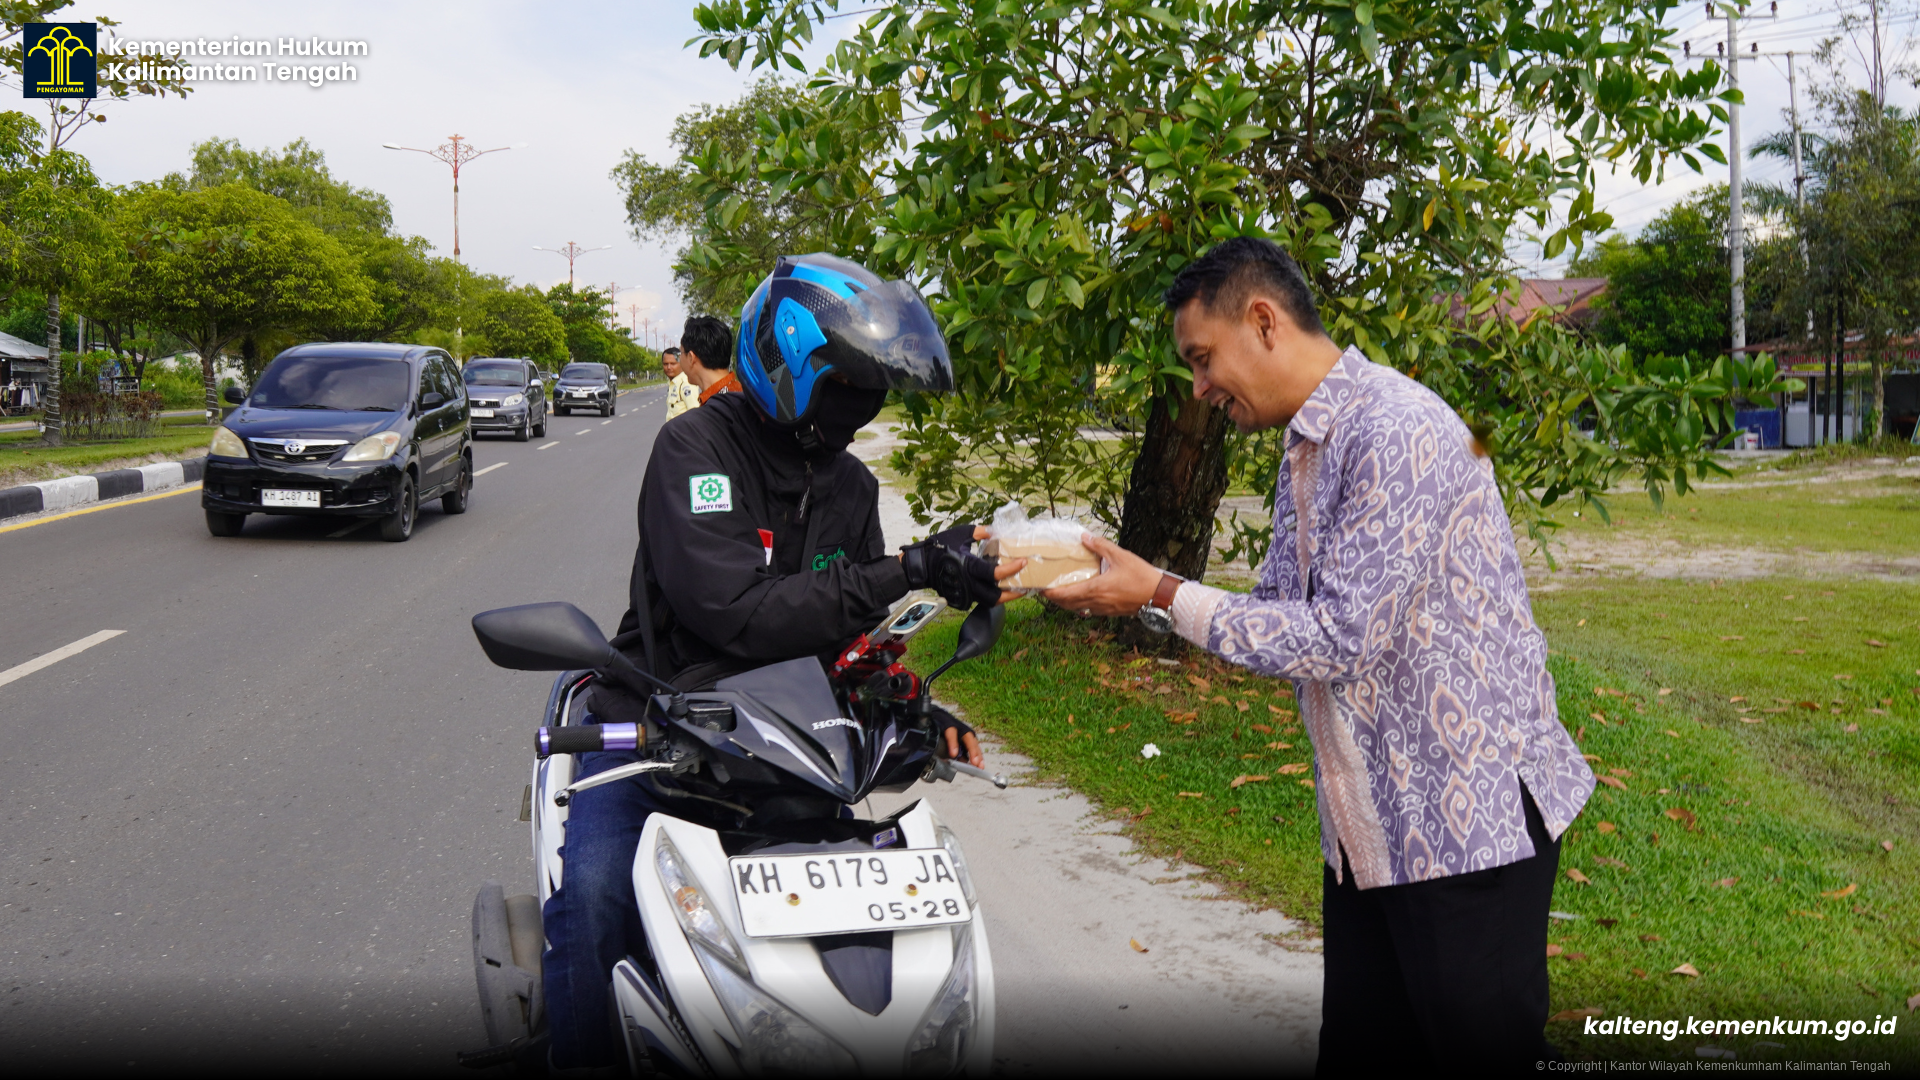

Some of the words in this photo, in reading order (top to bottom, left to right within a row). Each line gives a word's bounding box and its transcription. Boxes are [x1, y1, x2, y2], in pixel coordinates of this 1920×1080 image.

[263, 491, 275, 500] KH
[812, 717, 863, 731] HONDA
[737, 862, 782, 894] KH
[805, 857, 889, 890] 6179
[915, 854, 955, 884] JA
